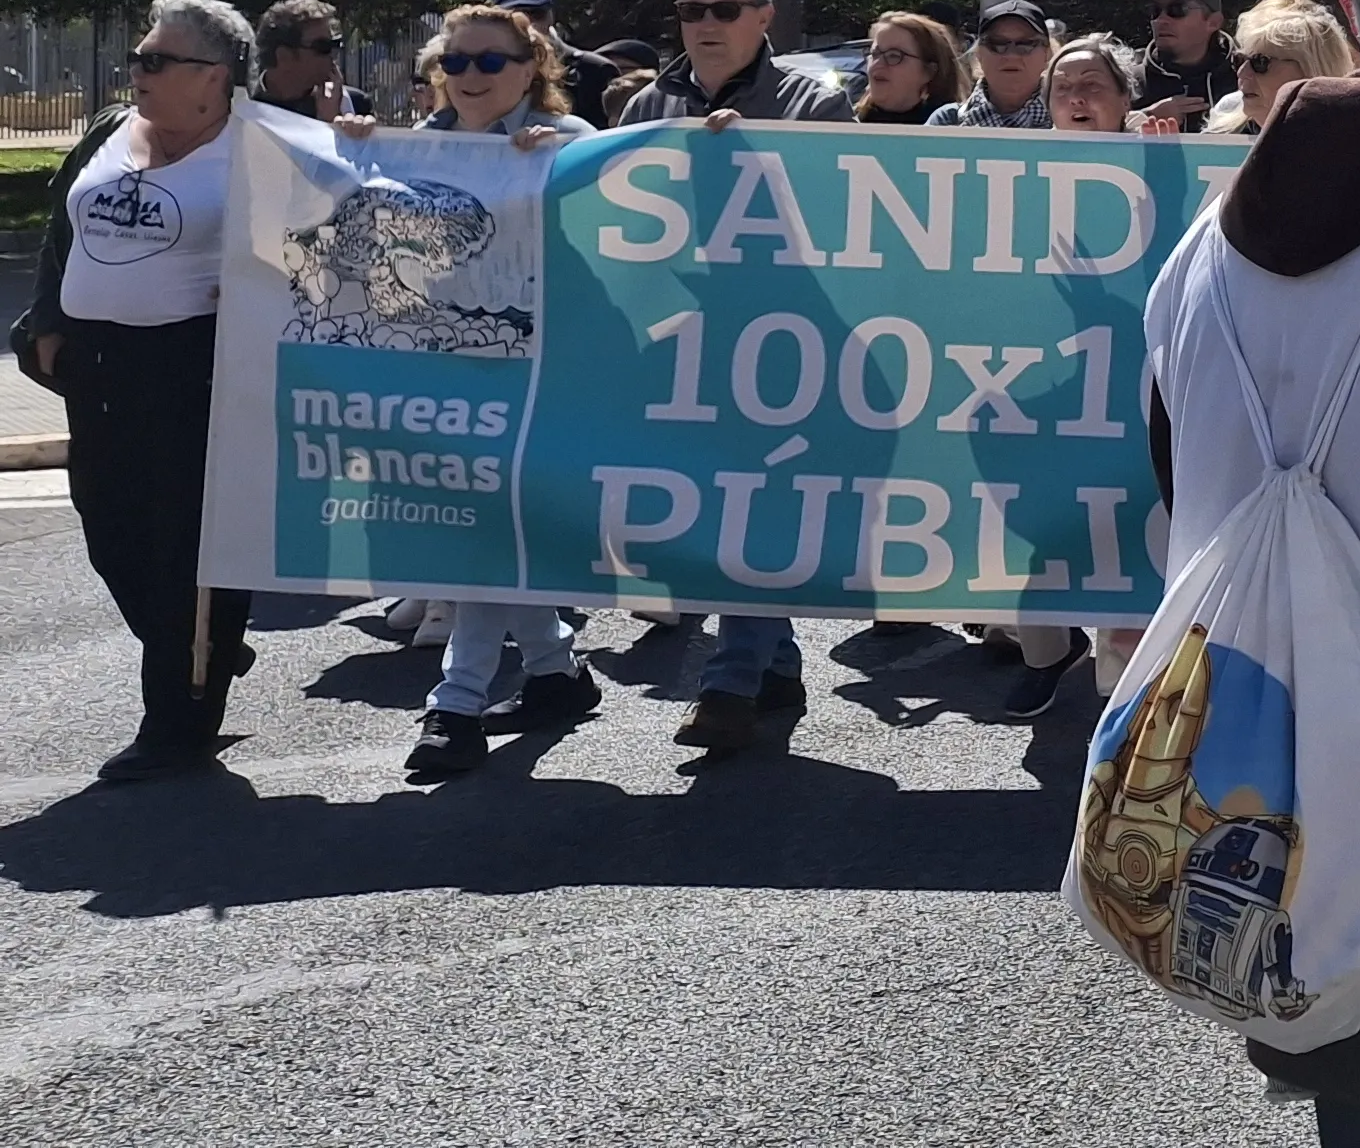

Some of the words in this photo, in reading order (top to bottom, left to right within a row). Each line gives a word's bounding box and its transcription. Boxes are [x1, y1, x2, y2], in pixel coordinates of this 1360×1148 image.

[644, 310, 1152, 438] 100x1
[291, 387, 509, 438] mareas
[294, 431, 502, 493] blancas
[320, 493, 477, 528] gaditanas
[591, 434, 1170, 592] PÚBLI
